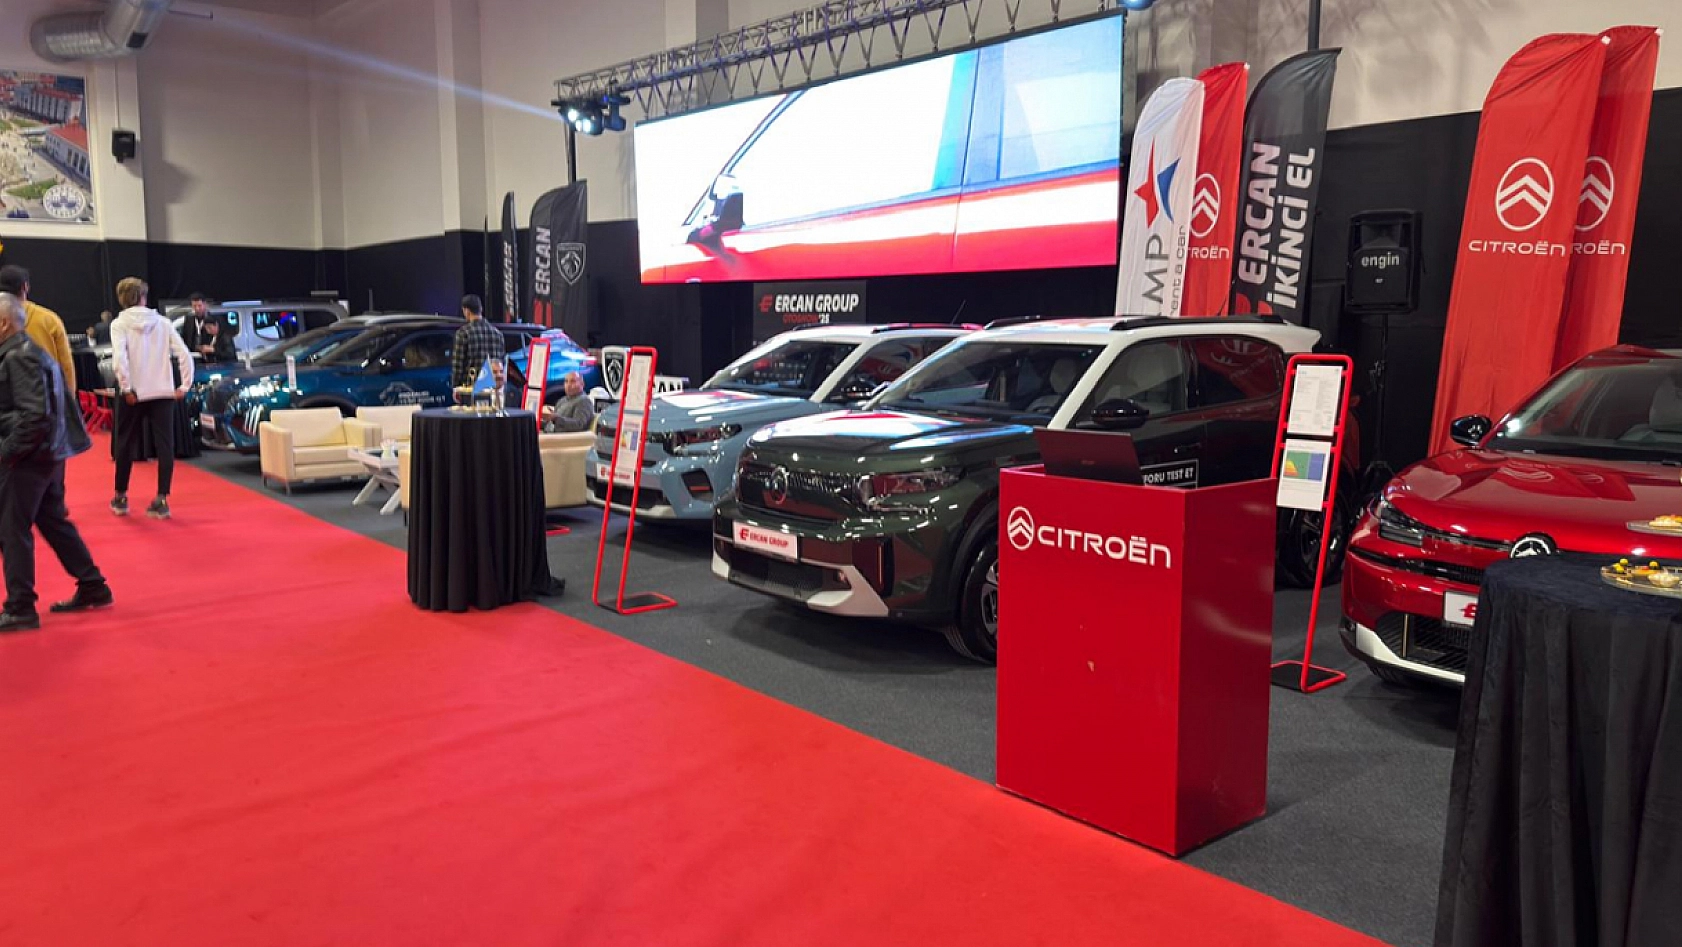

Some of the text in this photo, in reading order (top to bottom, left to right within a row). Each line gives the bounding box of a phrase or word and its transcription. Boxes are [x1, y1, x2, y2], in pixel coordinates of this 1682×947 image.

[1238, 141, 1281, 284] ERCAN
[1266, 148, 1316, 309] İKİNCİ EL
[535, 226, 551, 295] ERCAN
[1176, 225, 1186, 259] car
[1361, 251, 1400, 269] engin
[1572, 239, 1625, 255] ROËN
[1142, 233, 1169, 315] MP
[774, 294, 814, 312] ERCAN
[815, 293, 859, 312] GROUP
